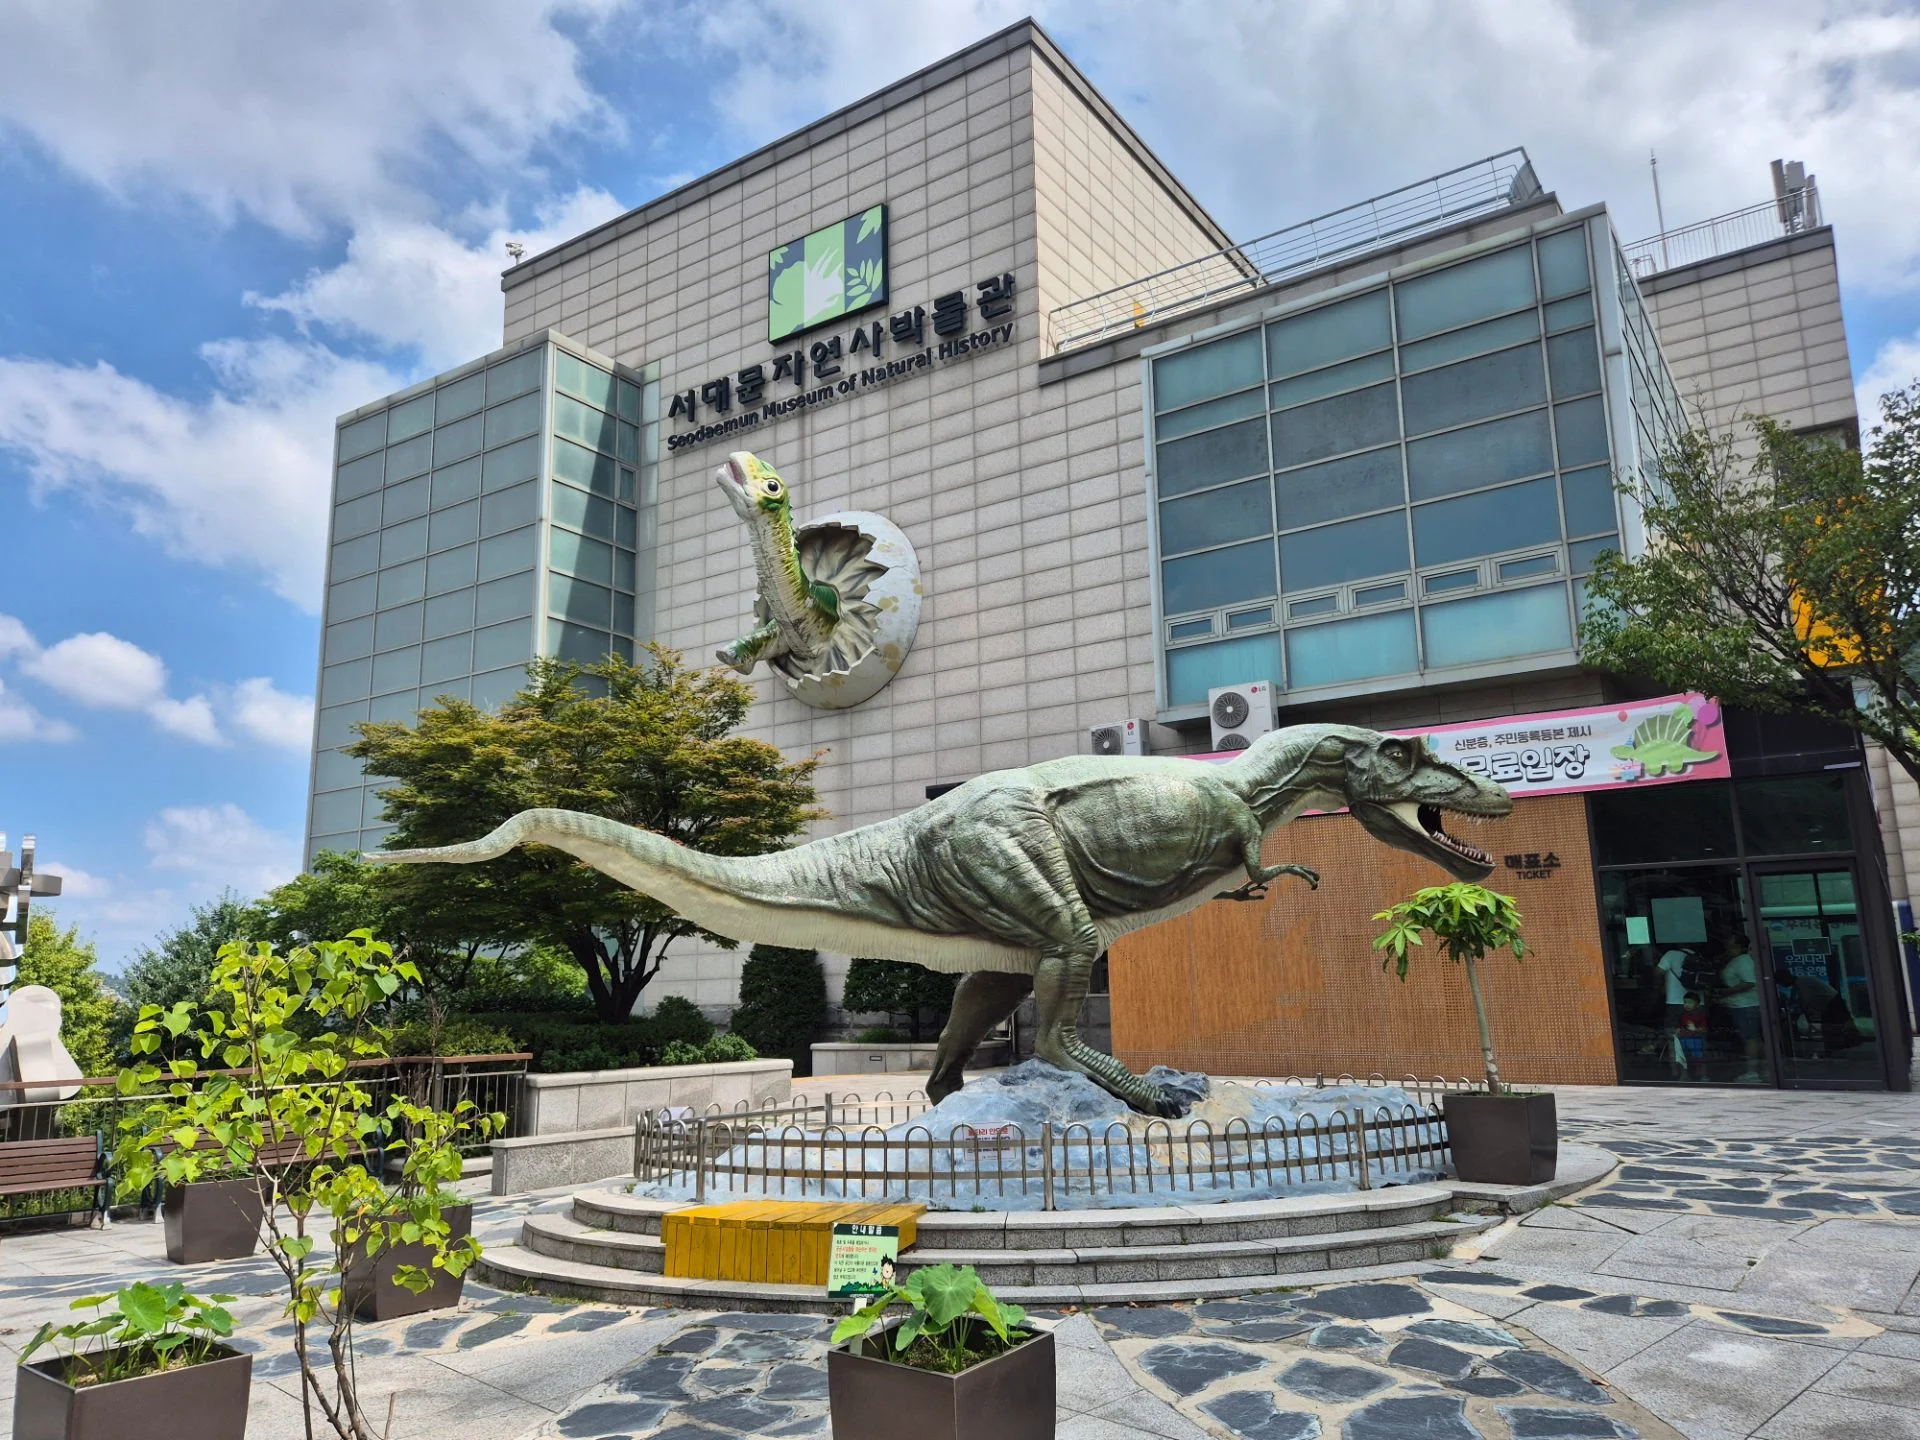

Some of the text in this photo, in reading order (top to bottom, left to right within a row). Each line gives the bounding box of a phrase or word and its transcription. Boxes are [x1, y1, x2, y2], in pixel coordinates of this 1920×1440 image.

[667, 272, 1016, 422] 서대문자연사박물관
[667, 321, 1014, 450] Seodaemun Museum of Natural History
[1454, 724, 1592, 751] 신분증, 주민등록등본 제시
[1504, 851, 1561, 869] 매표소
[1516, 870, 1551, 879] TICKET
